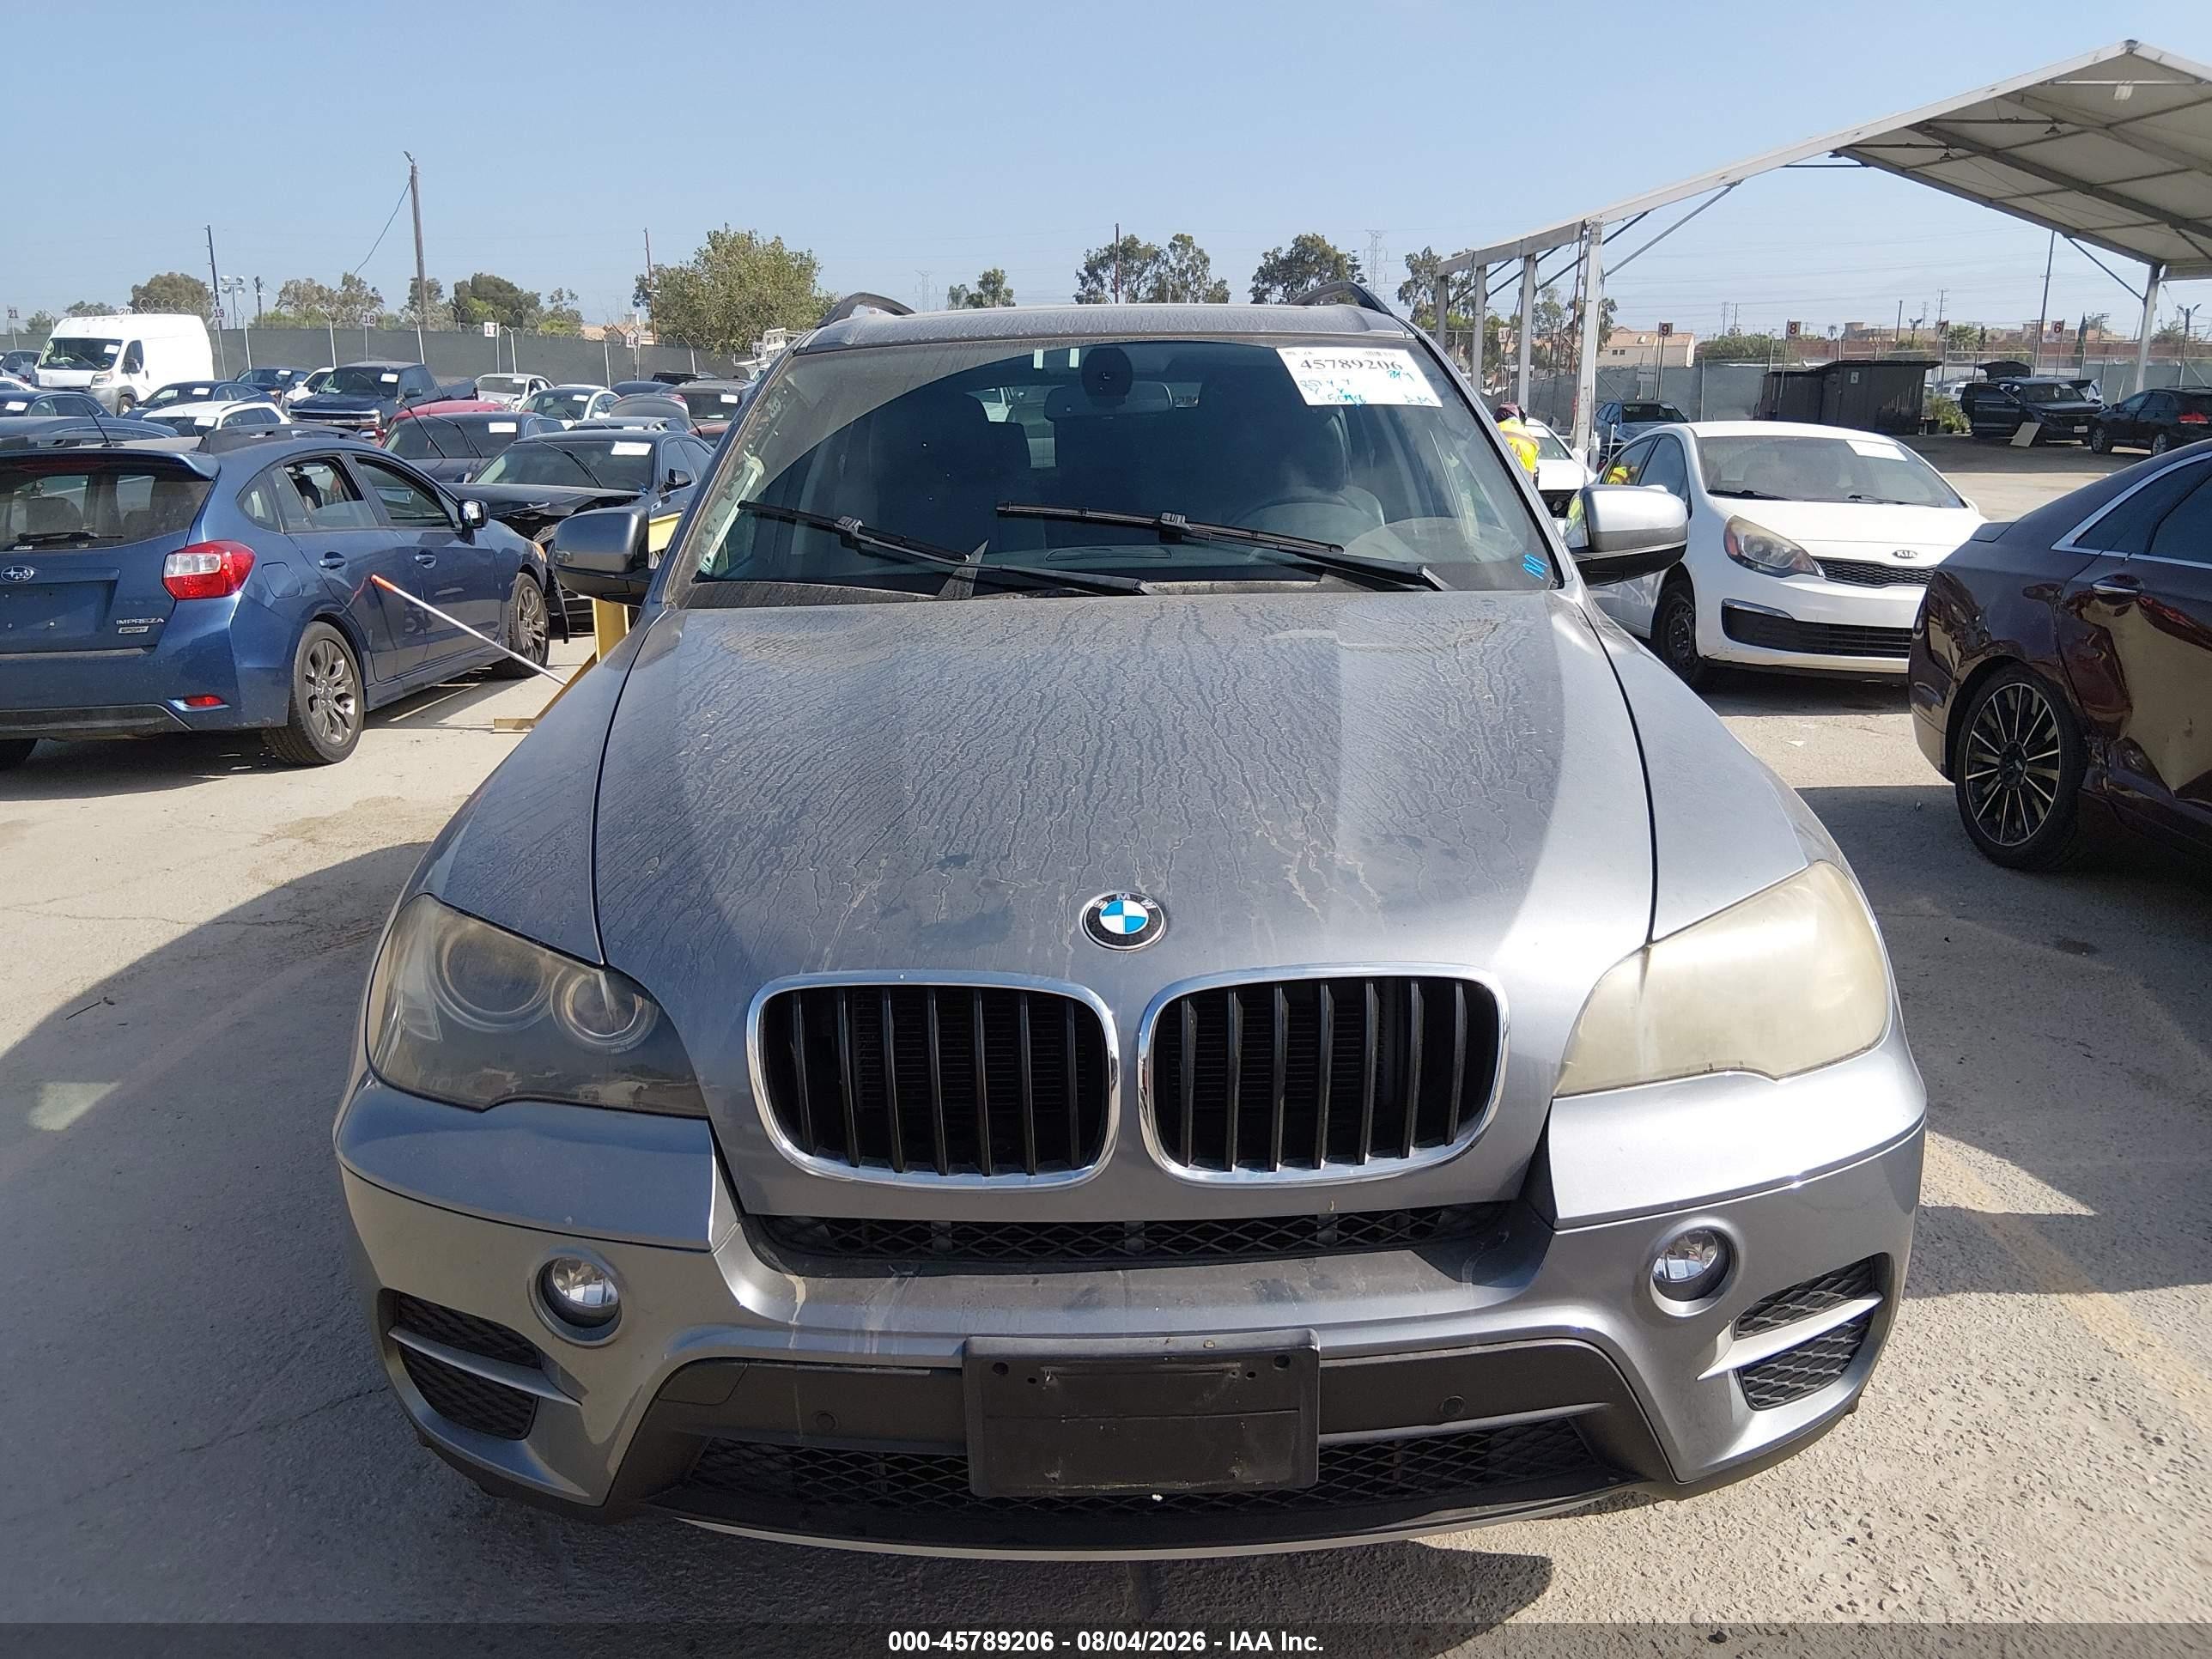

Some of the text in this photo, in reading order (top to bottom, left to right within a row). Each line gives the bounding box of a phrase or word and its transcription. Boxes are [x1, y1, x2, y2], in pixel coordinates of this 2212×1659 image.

[8, 309, 18, 318] 21
[214, 309, 224, 318] 19
[364, 315, 375, 324] 18
[1662, 324, 1669, 336] 9
[1790, 323, 1797, 334] 8
[1938, 322, 1947, 334] 7
[2054, 322, 2061, 333] 6
[1300, 359, 1403, 370] 45789206
[1093, 893, 1158, 908] BMW
